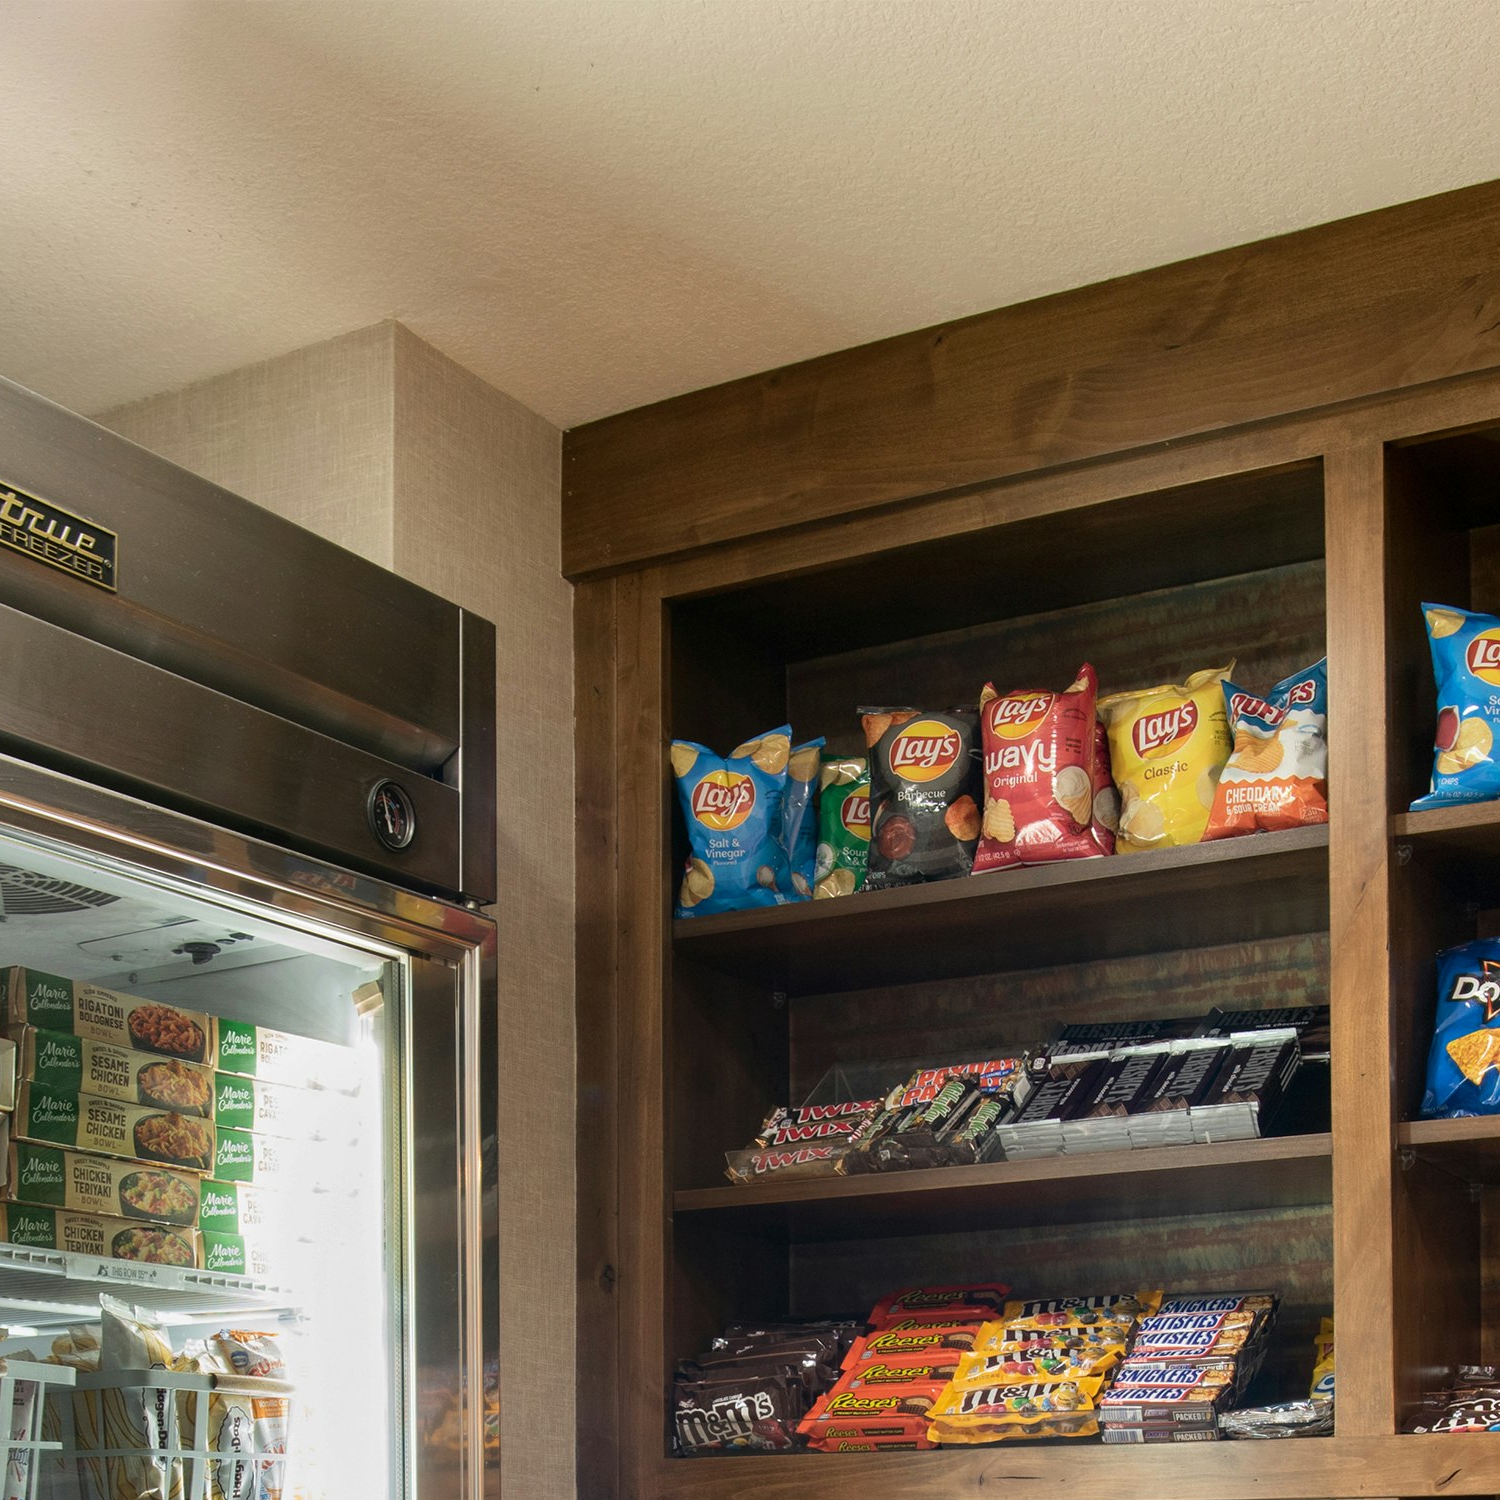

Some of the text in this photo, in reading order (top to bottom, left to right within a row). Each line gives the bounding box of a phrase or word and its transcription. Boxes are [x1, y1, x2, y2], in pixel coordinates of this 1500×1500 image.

[1138, 706, 1193, 752] Lay's
[894, 734, 956, 767] Lay's
[985, 739, 1056, 775] wavy
[1144, 760, 1189, 781] Classic
[993, 773, 1038, 789] Original
[898, 789, 946, 802] Barbecue
[709, 838, 740, 849] Salt &
[705, 848, 745, 860] Vinegar
[34, 984, 68, 1000] Marie
[30, 997, 72, 1011] Callender's
[78, 998, 124, 1019] RIGATONI
[79, 1010, 124, 1030] BOLOGNESE
[42, 1041, 76, 1058] Marie
[39, 1055, 81, 1069] Callender's
[91, 1055, 130, 1073] SESAME
[90, 1068, 130, 1087] CHICKEN
[35, 1096, 73, 1112] Marie
[797, 1100, 876, 1124] TWIX
[32, 1110, 76, 1123] Callender's
[88, 1108, 126, 1127] SESAME
[86, 1122, 126, 1141] CHICKEN
[772, 1121, 854, 1146] TWIX
[24, 1157, 60, 1173] Marie
[752, 1147, 833, 1174] TWIX
[73, 1167, 112, 1184] CHICKEN
[73, 1181, 112, 1198] TERIYAKI
[14, 1216, 50, 1231] Marie
[63, 1225, 104, 1243] CHICKEN
[1163, 1296, 1242, 1314] SNICKERS
[1140, 1313, 1222, 1331] SATISFIES
[869, 1333, 944, 1350] Reese's
[857, 1363, 932, 1380] Reese's
[1117, 1369, 1204, 1384] SNICKERS
[827, 1393, 902, 1411] Reese's
[1175, 1411, 1202, 1421] PACKED
